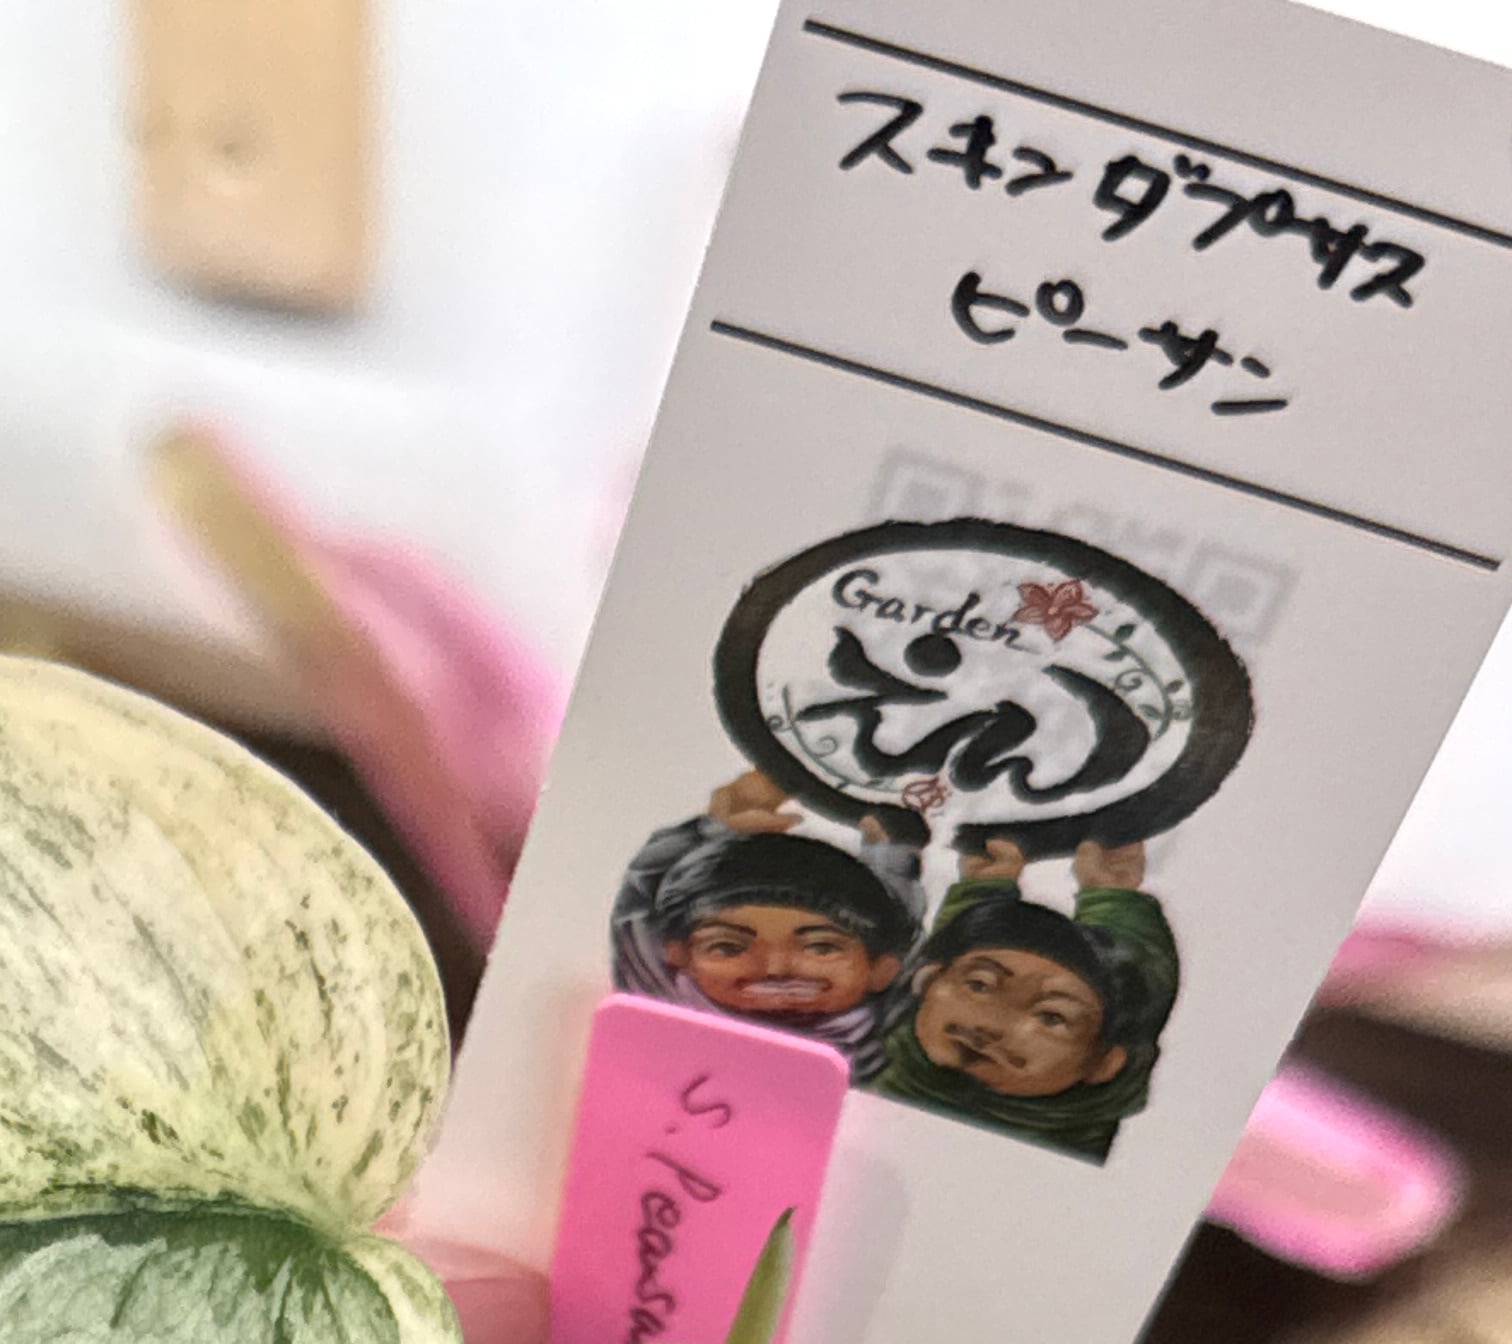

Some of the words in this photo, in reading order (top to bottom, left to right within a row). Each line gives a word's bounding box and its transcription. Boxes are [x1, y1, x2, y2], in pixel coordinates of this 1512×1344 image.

[950, 271, 1288, 417] ピーサン
[832, 568, 1034, 652] Garden
